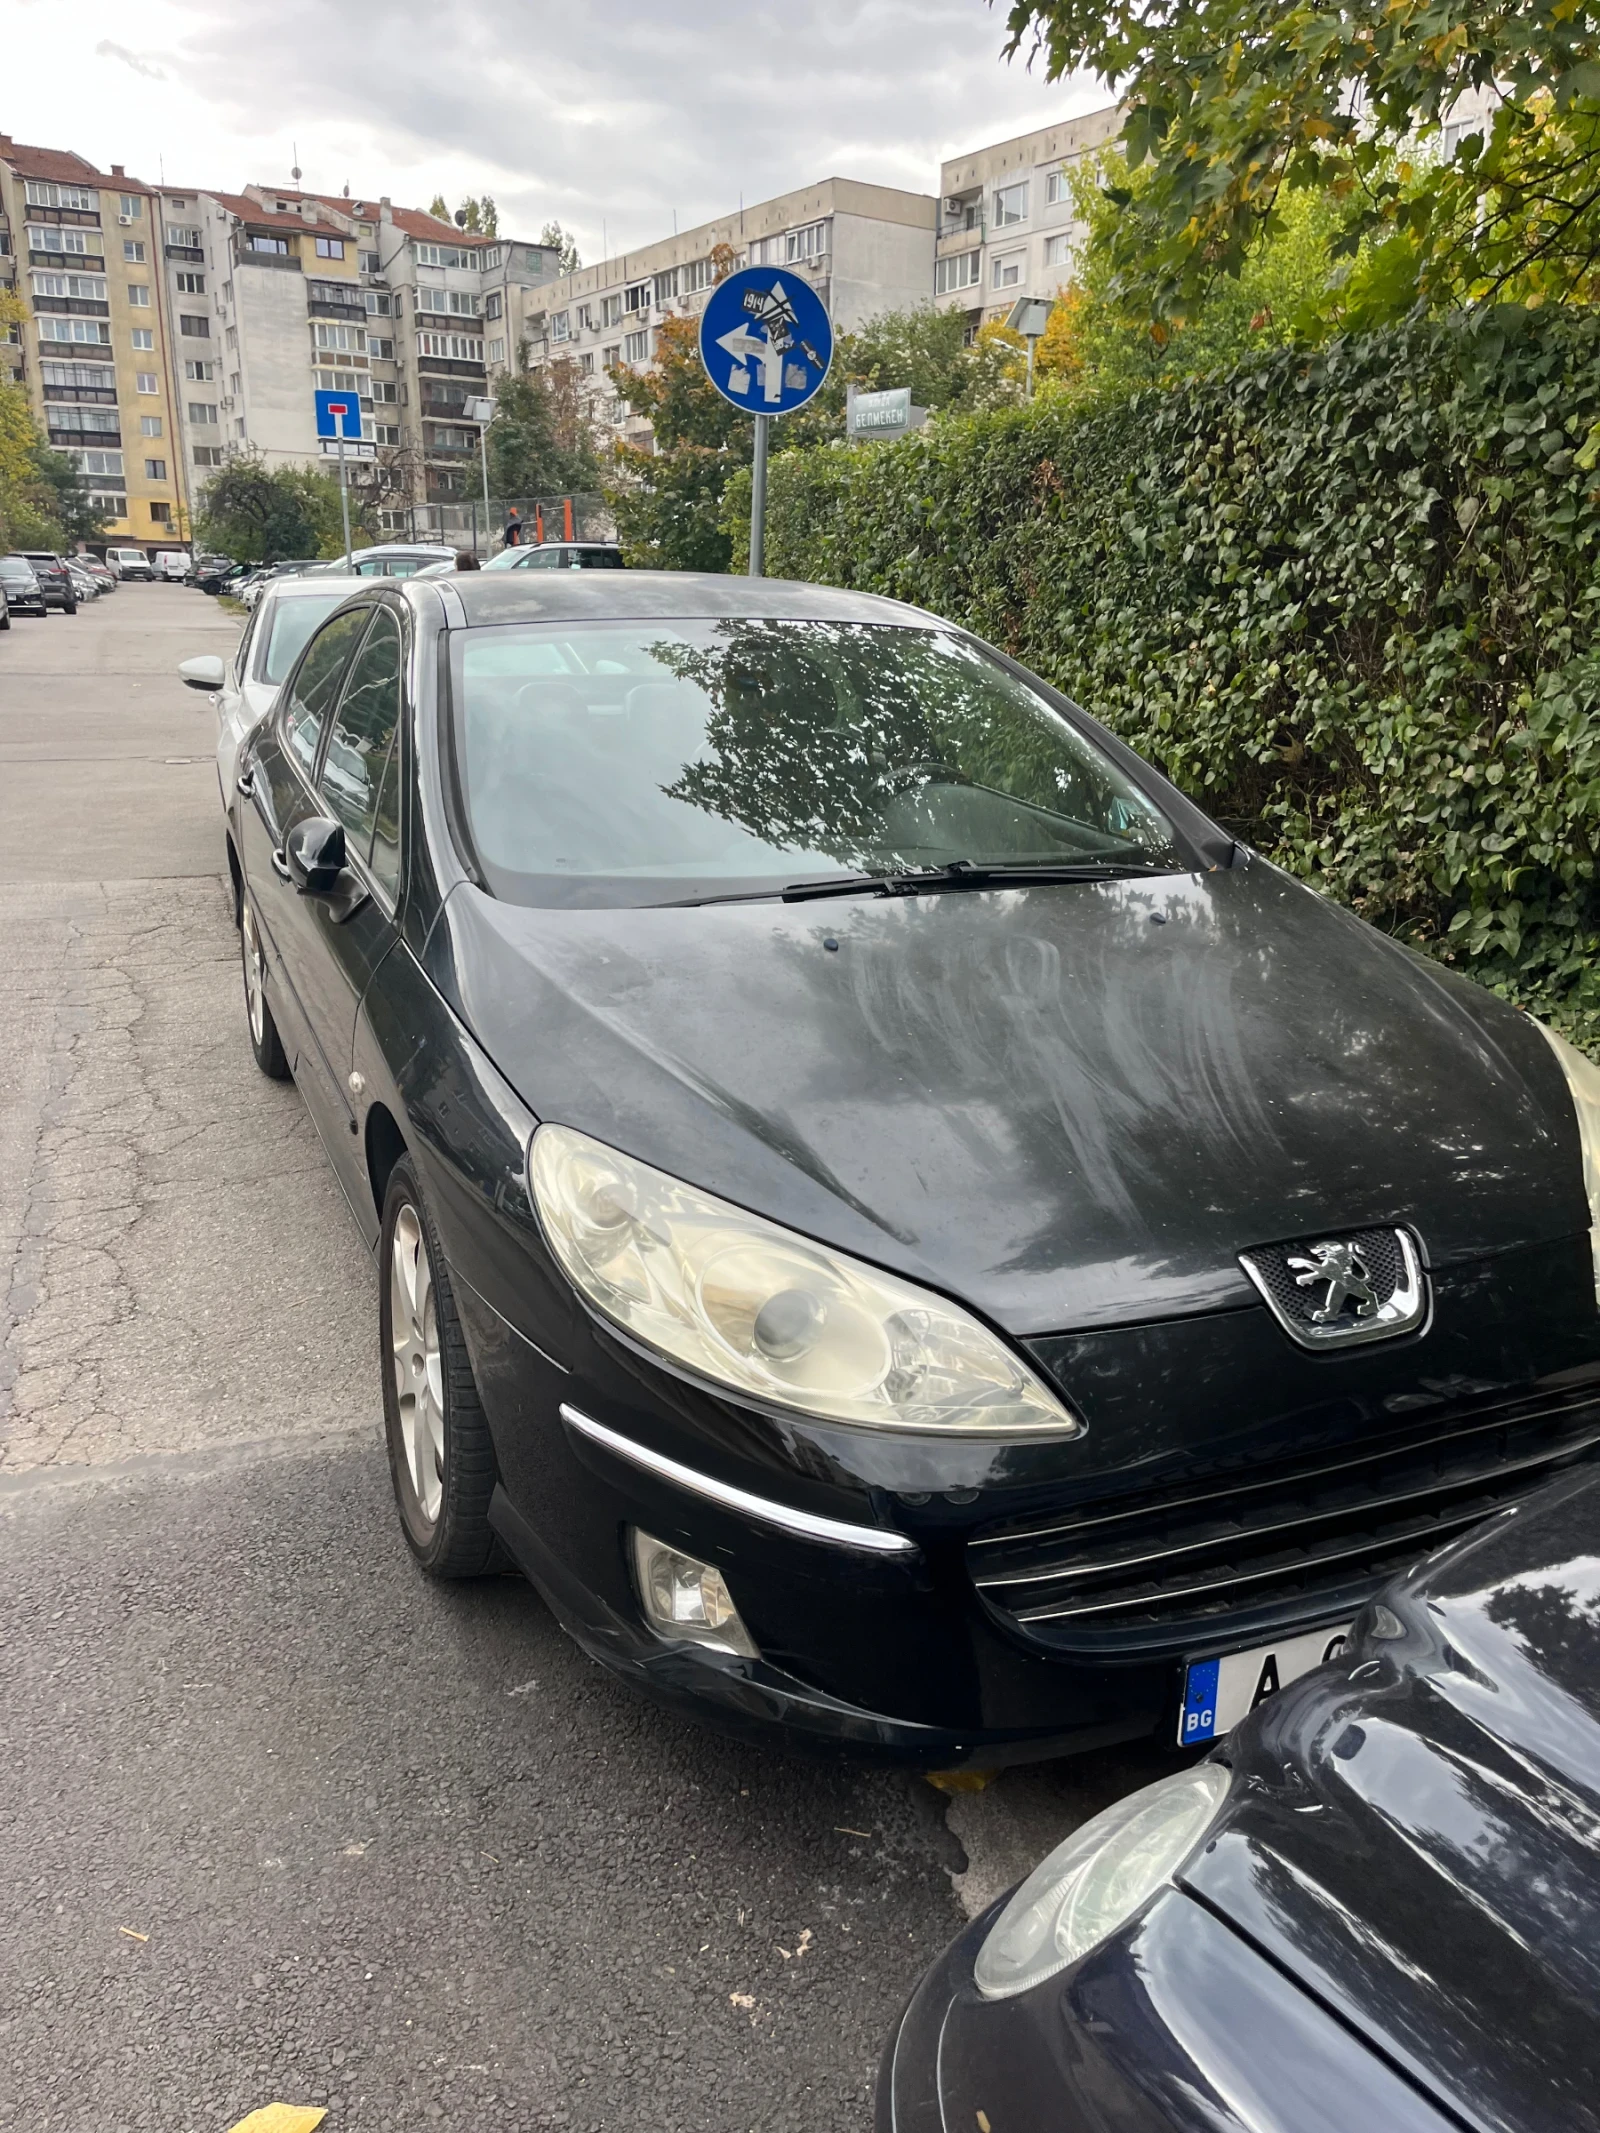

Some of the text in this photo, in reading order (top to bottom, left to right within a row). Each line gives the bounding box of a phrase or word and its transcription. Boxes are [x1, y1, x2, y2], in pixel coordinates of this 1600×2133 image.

[743, 293, 765, 311] 1914
[855, 408, 904, 428] БЕЛМЕКЕН
[1186, 1709, 1213, 1732] BG
